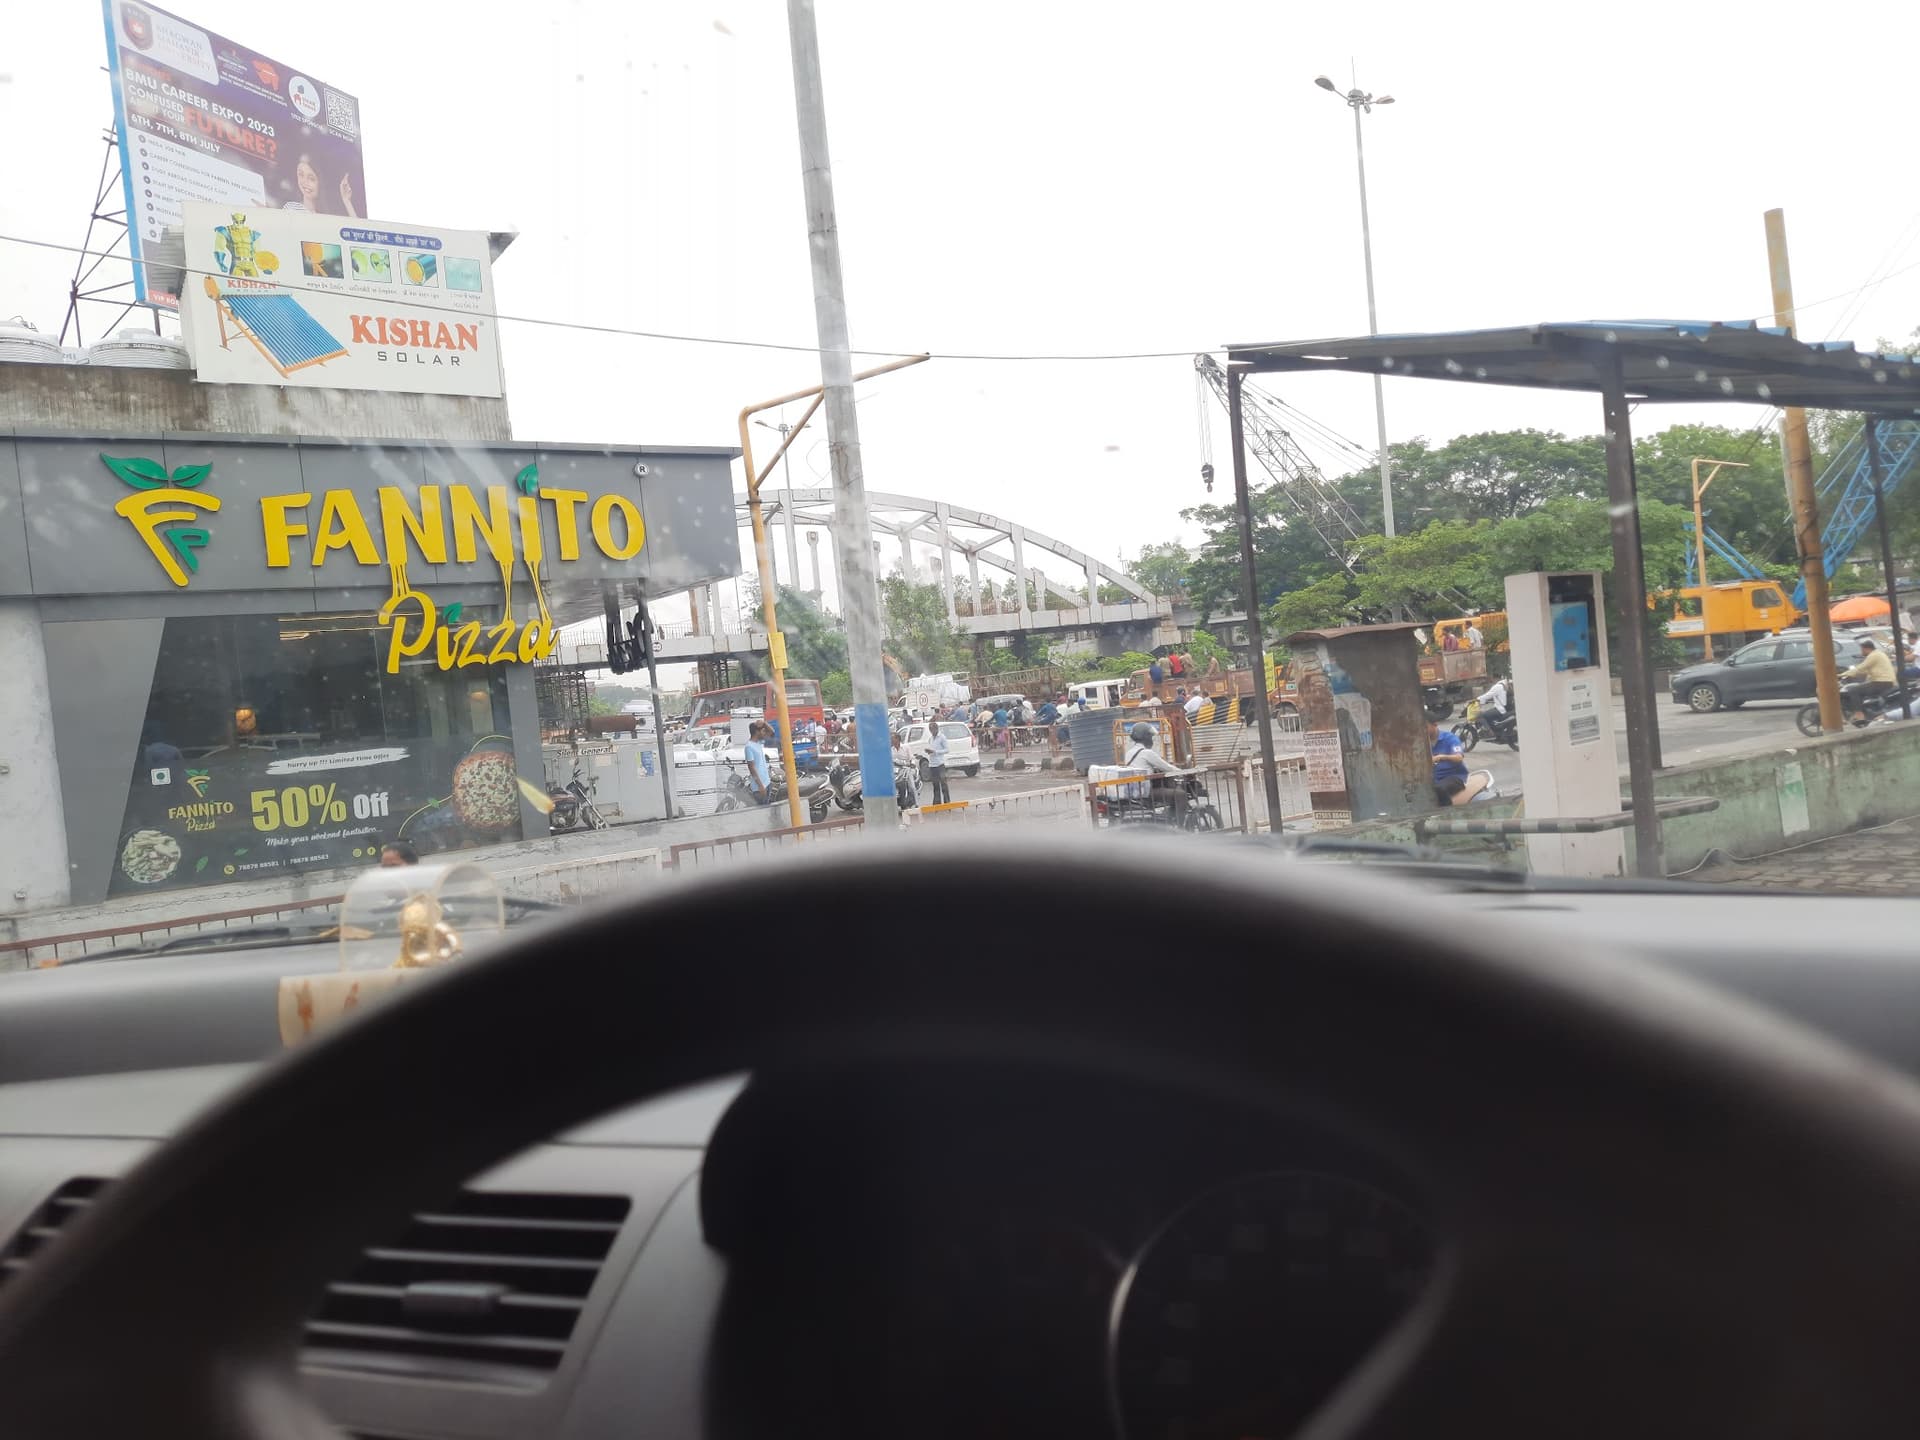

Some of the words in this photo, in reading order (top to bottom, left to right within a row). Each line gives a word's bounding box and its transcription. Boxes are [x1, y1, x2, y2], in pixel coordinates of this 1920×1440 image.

[125, 68, 157, 90] BMU
[161, 84, 208, 109] CAREER
[212, 103, 244, 124] EXPO
[247, 117, 275, 137] 2023
[128, 85, 184, 113] CONFUSED
[131, 114, 153, 129] 6TH,
[156, 122, 177, 138] 7TH,
[199, 137, 220, 153] JULY
[185, 105, 278, 158] FUTURE?
[350, 314, 479, 353] KISHAN
[377, 350, 461, 367] SOLAR
[377, 591, 561, 675] Pizza
[186, 817, 216, 831] Pizza
[250, 782, 347, 831] 50%
[353, 792, 389, 820] Off
[290, 835, 309, 847] your
